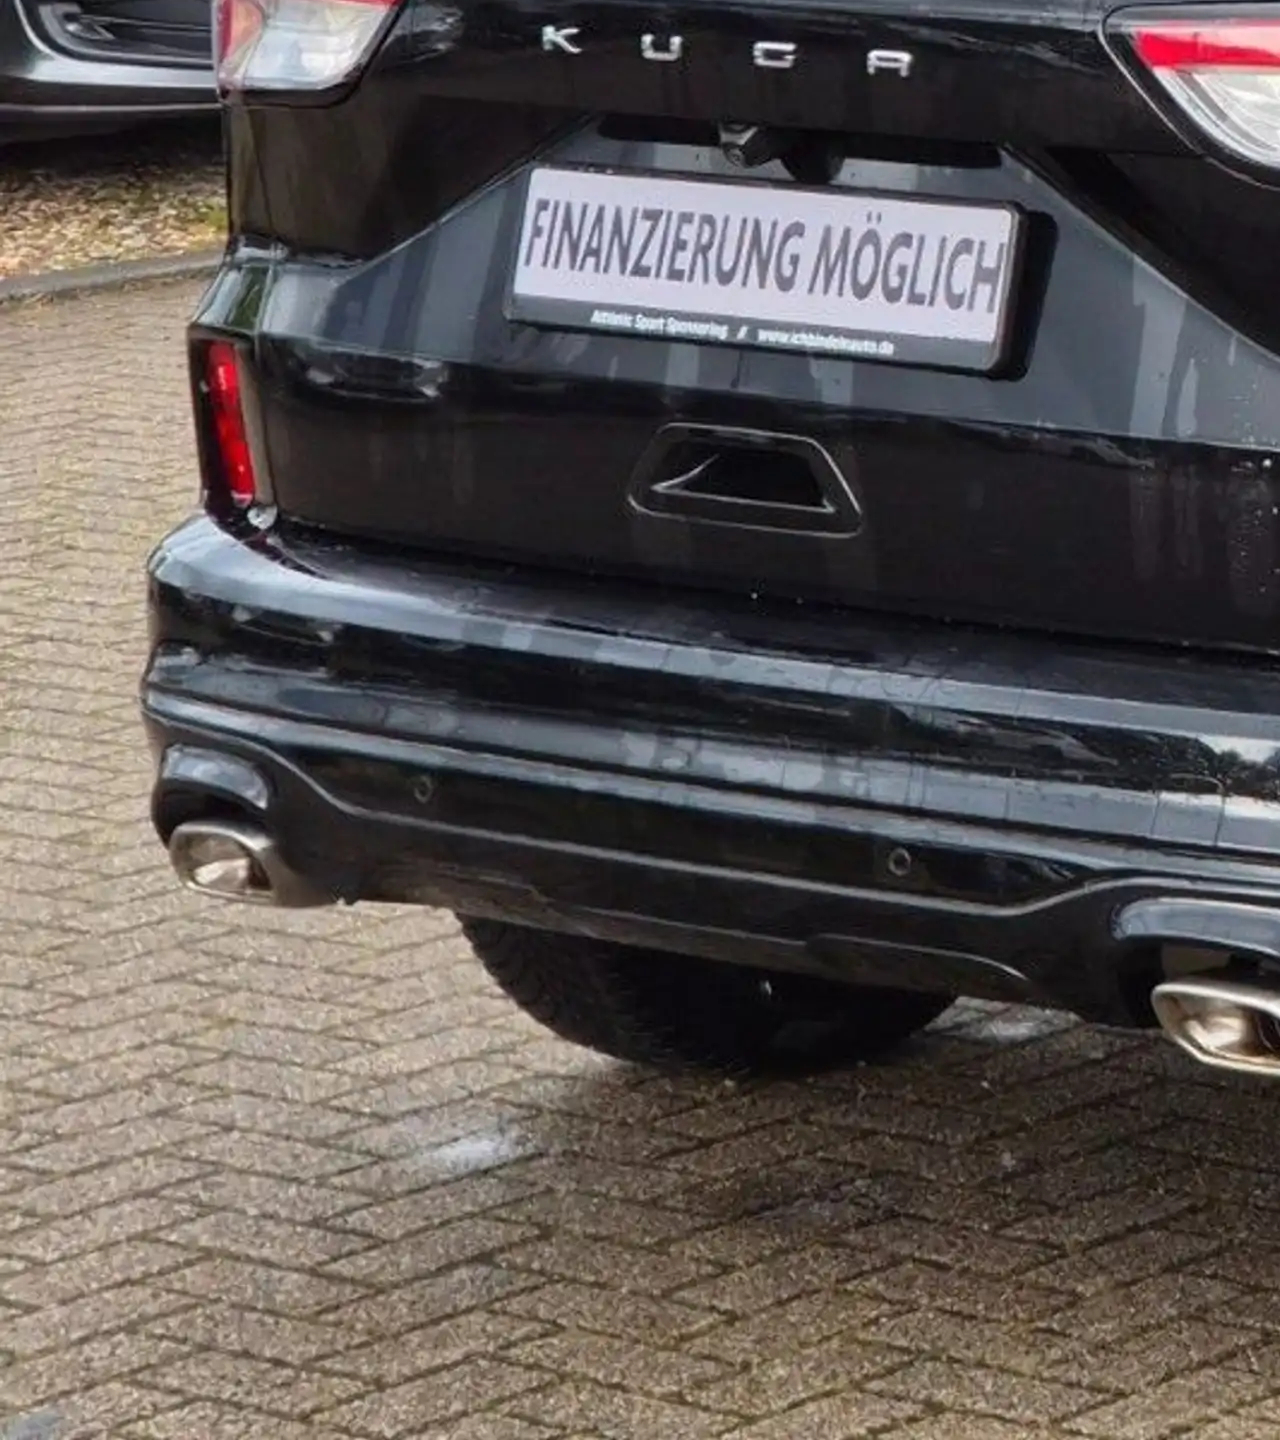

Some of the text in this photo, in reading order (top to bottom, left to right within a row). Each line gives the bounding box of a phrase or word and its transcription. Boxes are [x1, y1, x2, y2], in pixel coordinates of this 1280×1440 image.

[541, 24, 913, 78] KUGA
[523, 197, 1005, 315] FINANZIERUNG MÖGLICH
